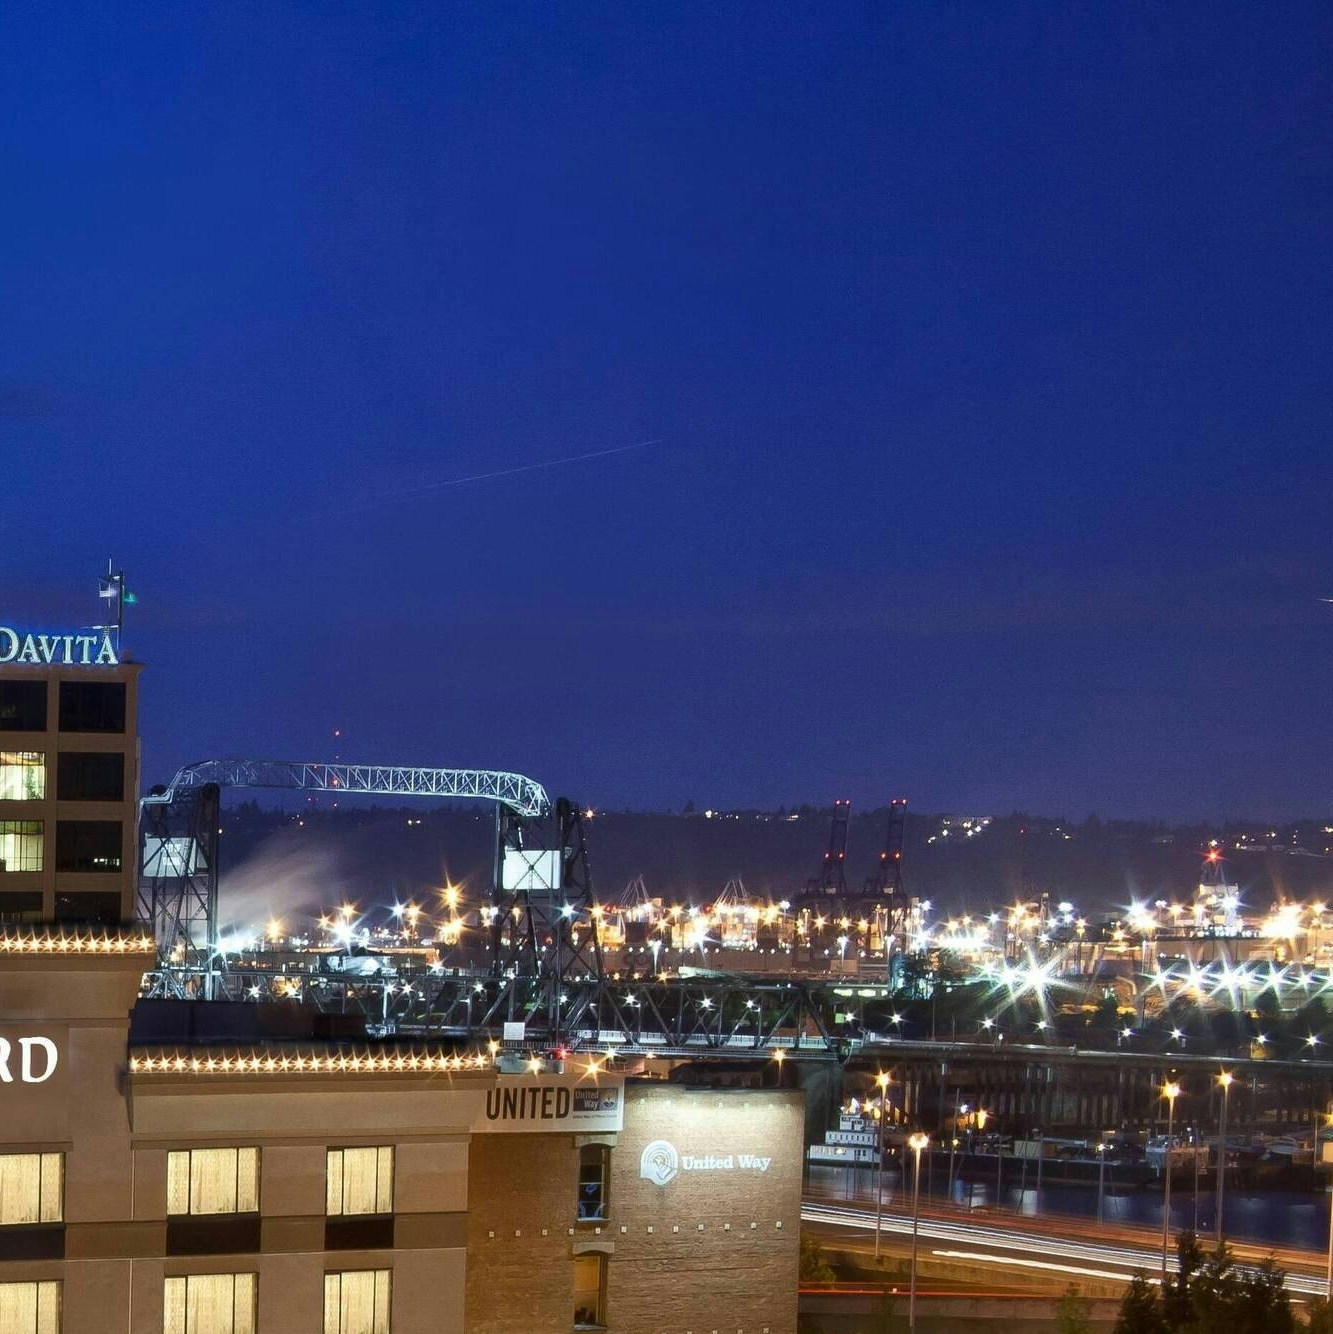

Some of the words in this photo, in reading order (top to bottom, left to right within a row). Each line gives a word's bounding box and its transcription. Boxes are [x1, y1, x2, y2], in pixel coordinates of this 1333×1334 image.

[486, 1086, 570, 1120] UNITED
[681, 1154, 734, 1170] United
[738, 1154, 772, 1171] Way
